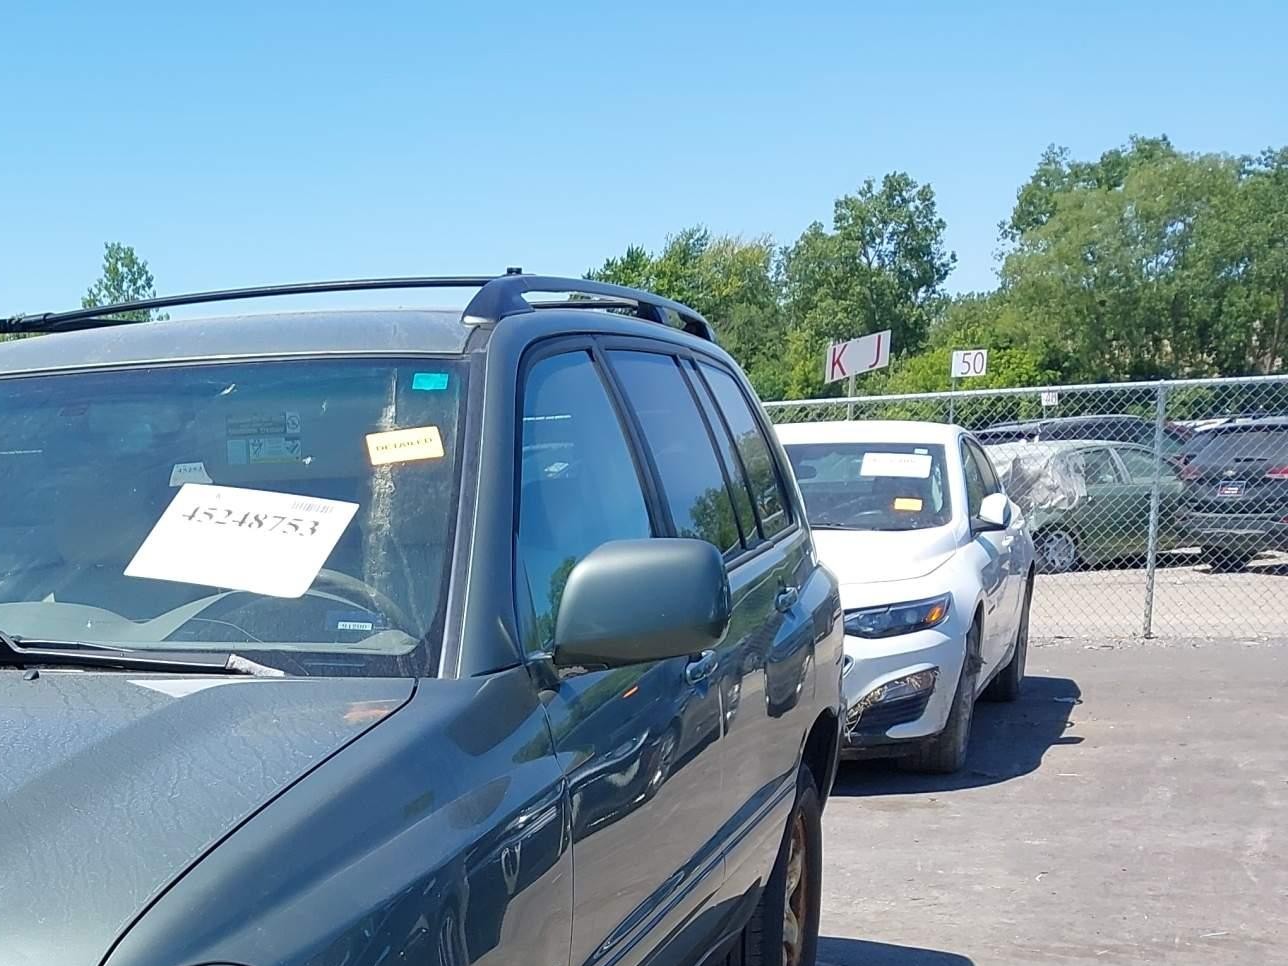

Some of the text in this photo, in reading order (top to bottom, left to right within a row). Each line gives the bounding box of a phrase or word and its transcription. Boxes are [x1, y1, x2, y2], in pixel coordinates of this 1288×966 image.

[830, 334, 881, 379] K J
[960, 351, 985, 375] 50
[181, 505, 320, 537] 45248753
